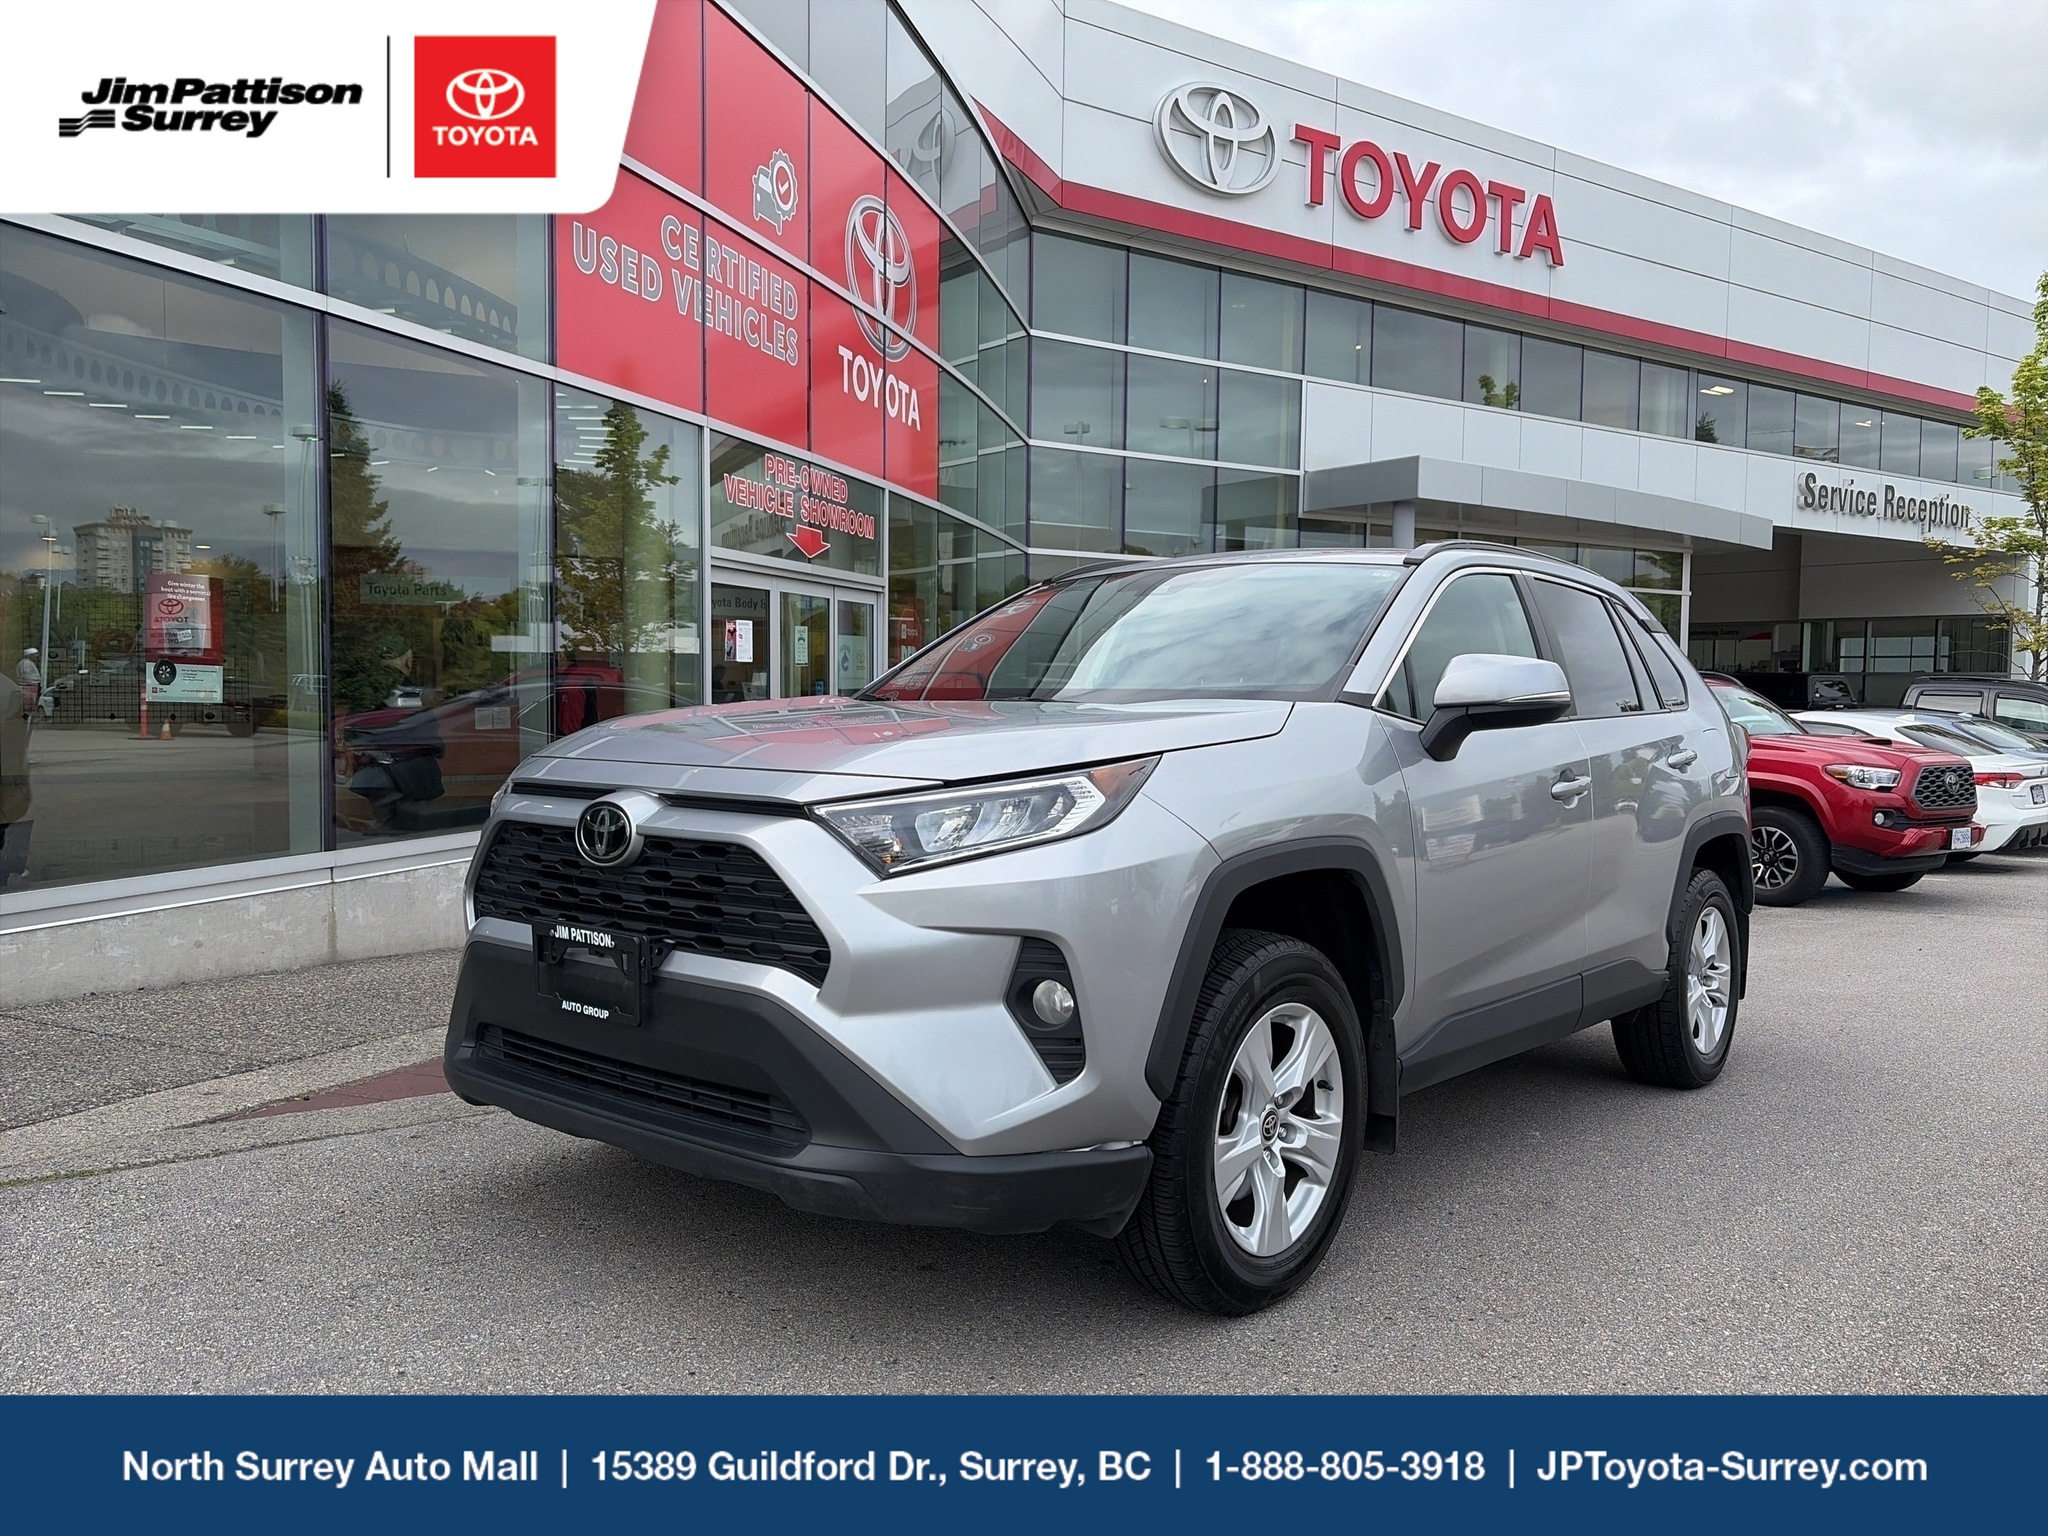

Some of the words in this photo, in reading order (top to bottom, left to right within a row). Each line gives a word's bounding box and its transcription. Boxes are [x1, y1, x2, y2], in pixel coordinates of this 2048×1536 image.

[1290, 123, 1565, 268] TOYOTA
[573, 221, 663, 301] USED
[671, 268, 798, 366] VEHICLES
[661, 215, 798, 320] CERTIFIED
[838, 345, 921, 431] TOYOTA
[723, 473, 794, 518] VEHICLE
[800, 496, 875, 540] SHOWROOM
[764, 453, 849, 504] PRE-OWNED
[1799, 472, 1877, 517] Service
[1884, 484, 1972, 533] Reception
[366, 582, 410, 598] Toyota
[413, 583, 447, 596] Parts
[735, 597, 759, 611] Body
[554, 925, 570, 940] JIM
[570, 927, 612, 948] PATTISON
[561, 1000, 582, 1013] AUTO
[583, 1004, 610, 1020] GROUP
